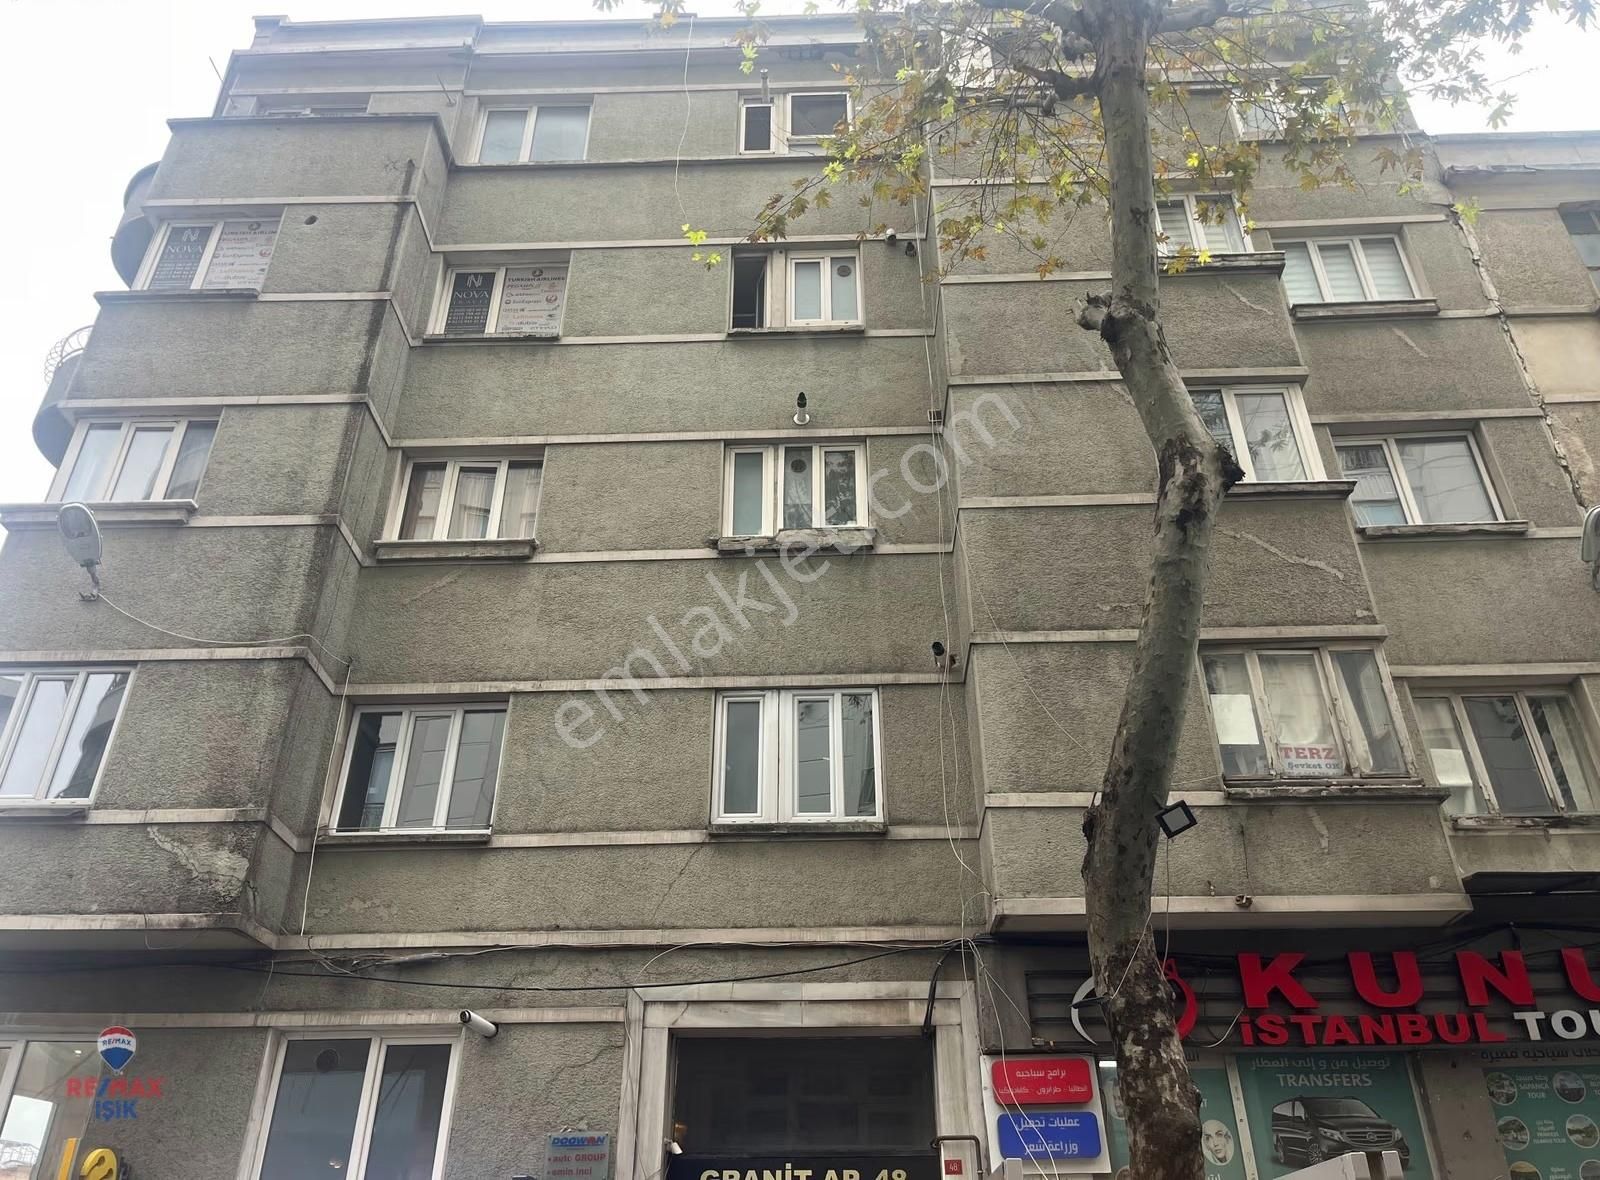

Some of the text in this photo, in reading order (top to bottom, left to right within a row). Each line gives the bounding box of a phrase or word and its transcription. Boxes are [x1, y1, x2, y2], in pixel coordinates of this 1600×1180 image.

[166, 245, 203, 253] NOVA
[453, 290, 489, 298] NOVA
[1047, 1068, 1067, 1080] برامج
[1276, 1073, 1372, 1087] TRANSFERS
[1048, 1116, 1081, 1130] عمليات
[552, 1152, 607, 1163] auto GROUP
[950, 1162, 958, 1171] 48
